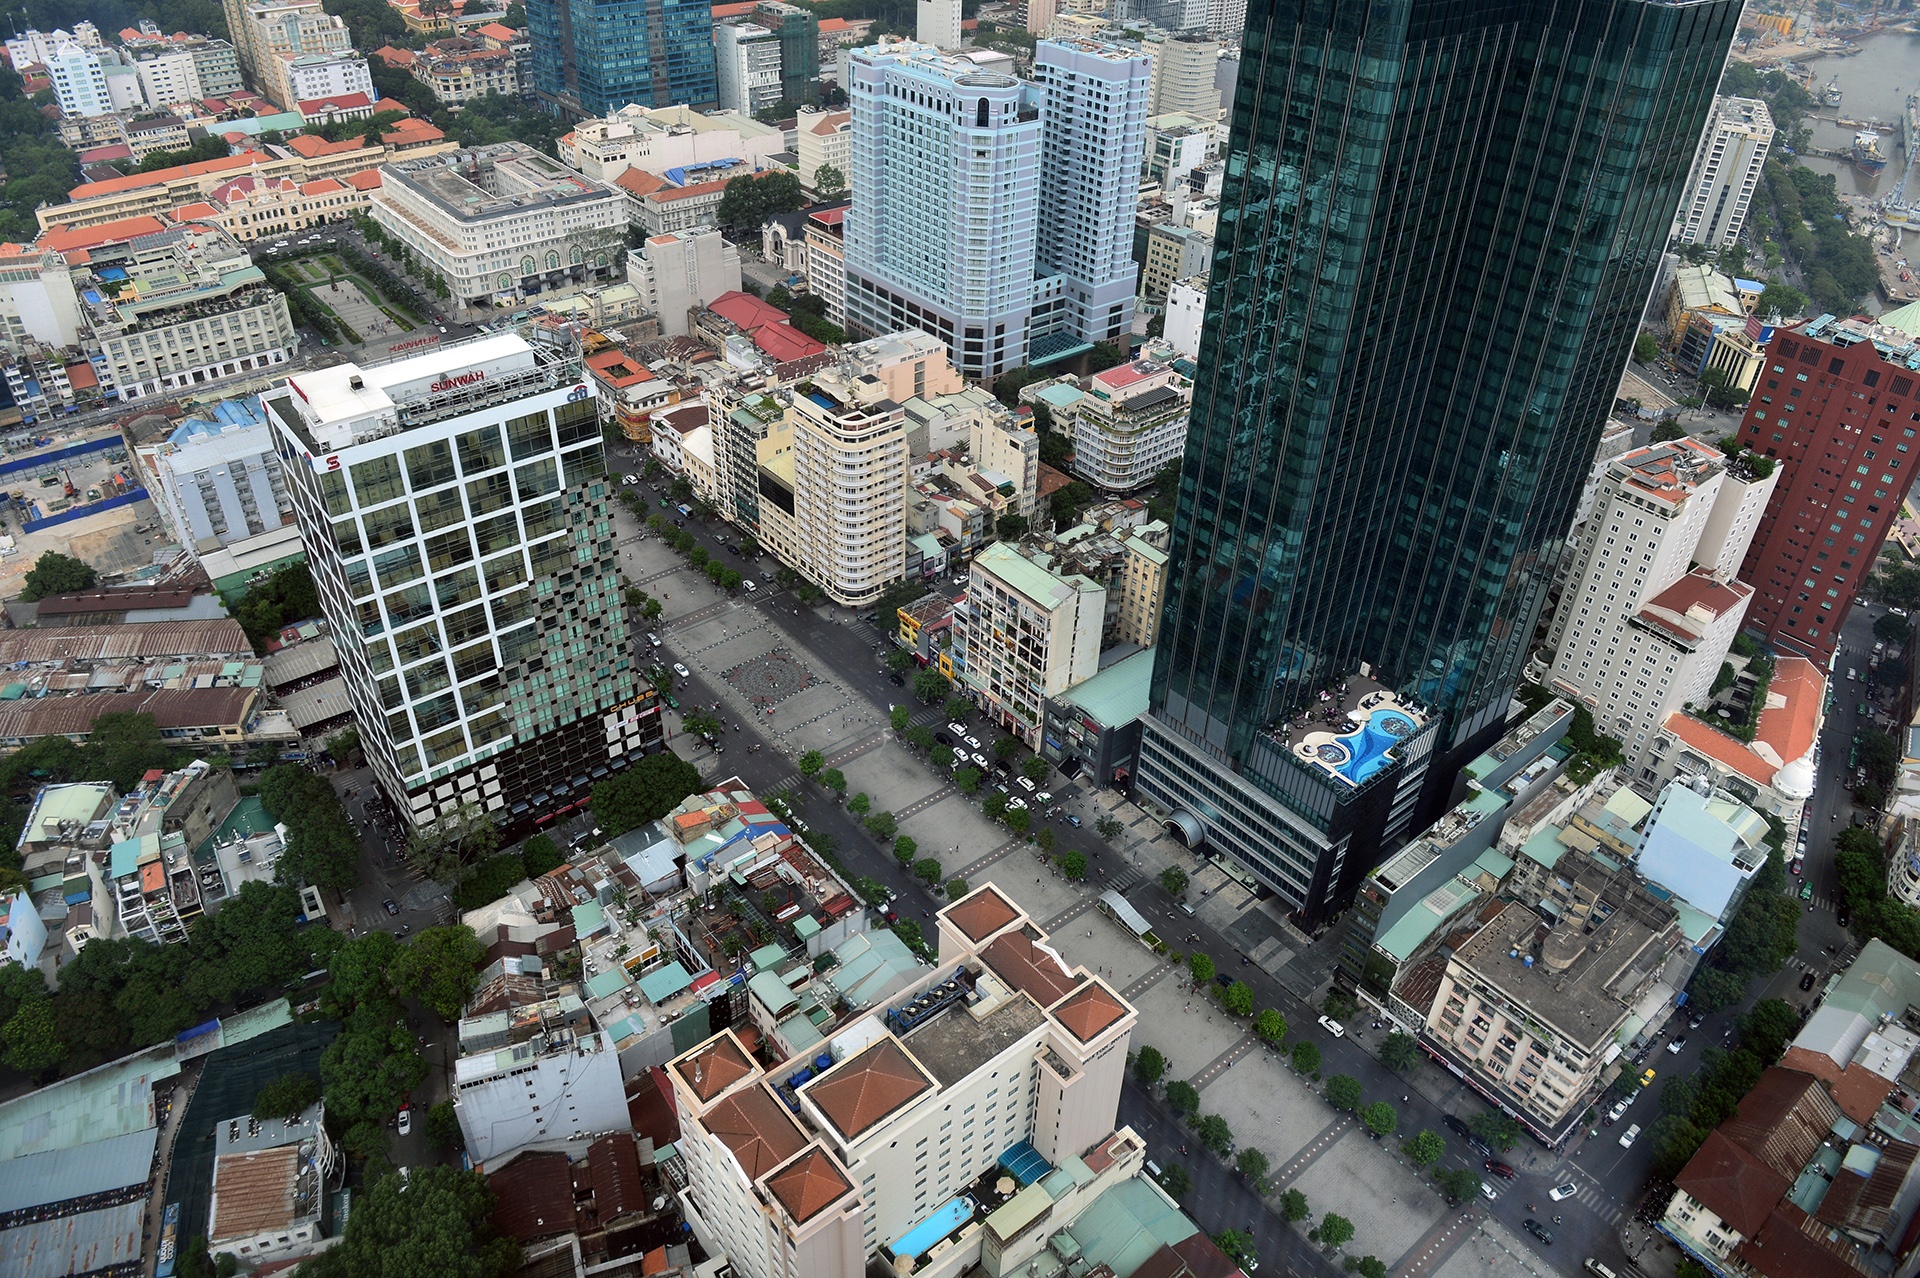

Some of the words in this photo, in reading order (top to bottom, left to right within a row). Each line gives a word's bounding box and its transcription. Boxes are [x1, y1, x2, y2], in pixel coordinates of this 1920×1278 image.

[431, 371, 484, 392] SUNWAH
[567, 385, 588, 402] citi
[610, 690, 654, 712] CHUBB
[1082, 1043, 1109, 1066] DUXTON
[1111, 1028, 1131, 1044] HOTEL
